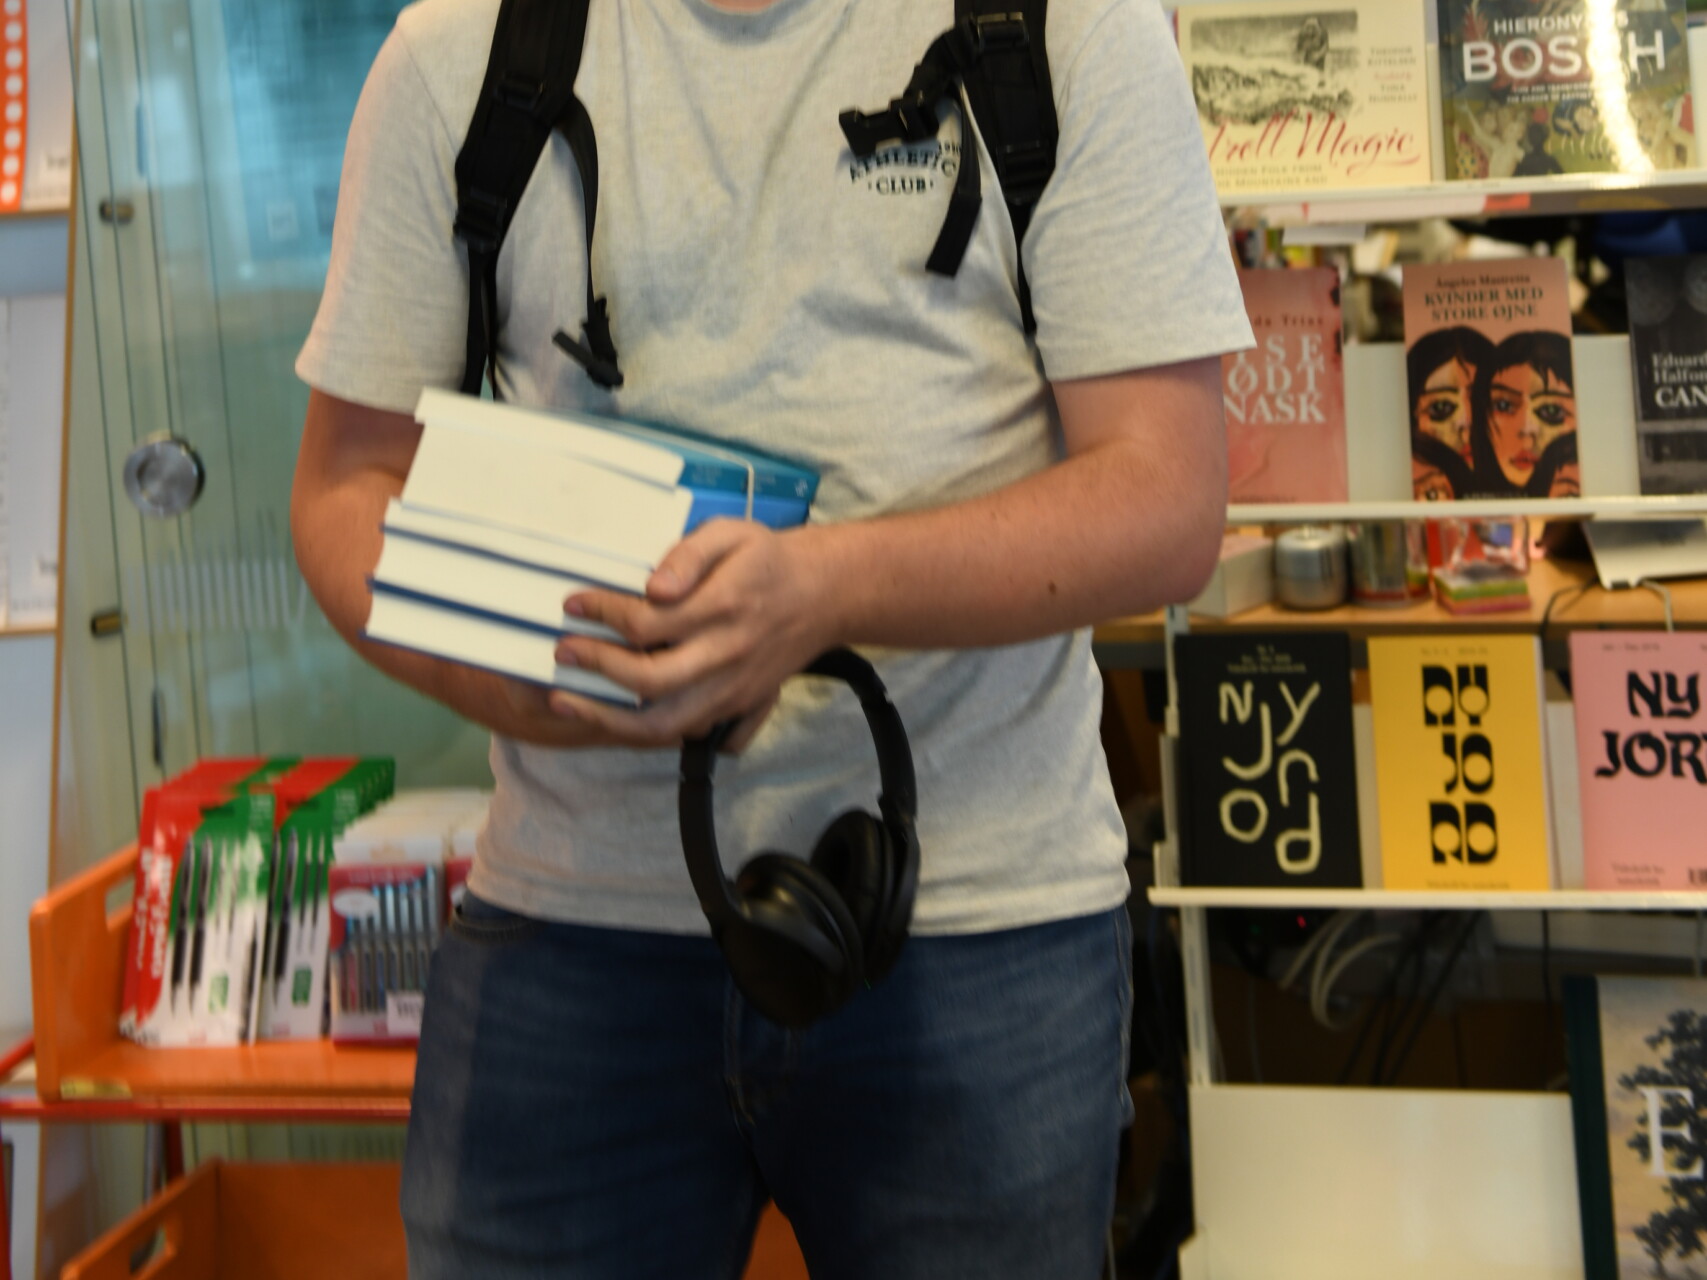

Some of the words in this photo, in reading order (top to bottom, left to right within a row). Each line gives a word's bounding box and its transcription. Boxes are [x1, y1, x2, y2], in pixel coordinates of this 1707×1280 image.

[1493, 8, 1629, 35] HIERONYS
[1462, 29, 1666, 83] BOSH
[1296, 111, 1421, 176] Magic
[875, 175, 927, 195] CLUB
[1424, 289, 1500, 306] KVINDER
[1505, 286, 1544, 300] MED
[1432, 305, 1487, 321] STORE
[1652, 350, 1707, 367] Eduard
[1227, 361, 1324, 399] ØDT
[1222, 393, 1327, 425] NASK
[1655, 385, 1707, 408] CAN
[1594, 729, 1707, 786] JOR
